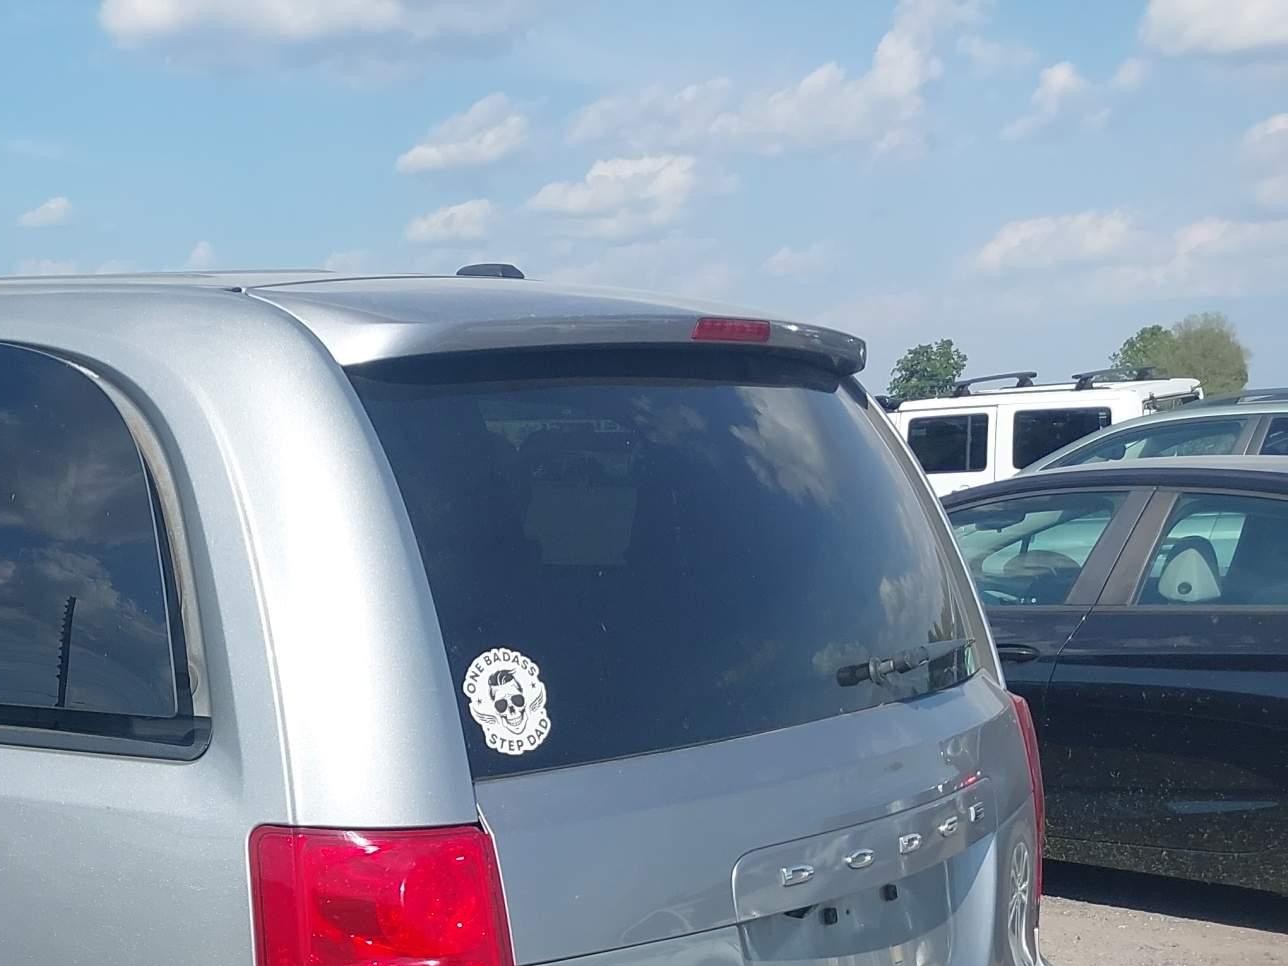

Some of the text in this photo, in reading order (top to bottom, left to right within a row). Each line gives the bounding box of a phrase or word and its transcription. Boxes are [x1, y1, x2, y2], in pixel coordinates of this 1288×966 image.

[467, 652, 537, 694] ONE BADASS
[488, 718, 549, 752] STEP DAD
[781, 801, 985, 887] DODGE
